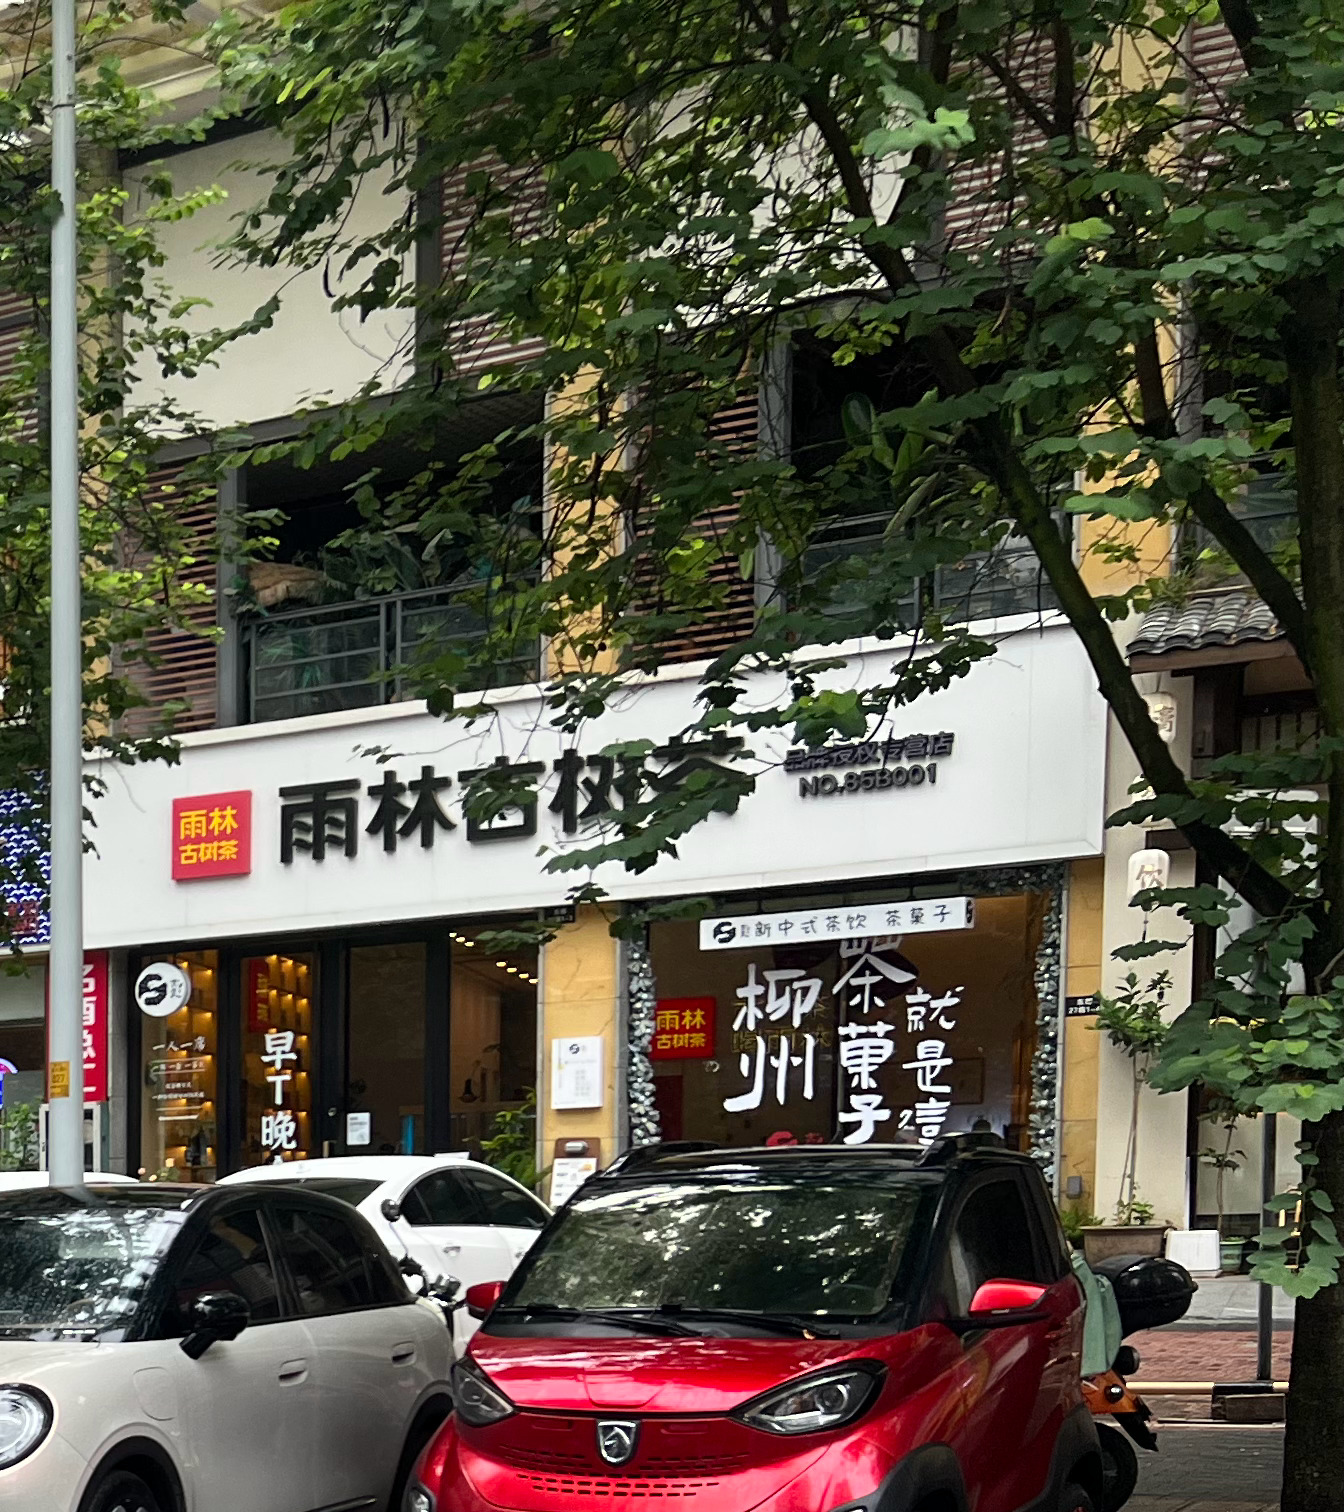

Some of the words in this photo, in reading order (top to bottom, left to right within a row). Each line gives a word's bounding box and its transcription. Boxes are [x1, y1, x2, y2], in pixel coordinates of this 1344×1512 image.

[179, 804, 239, 840] 雨林
[178, 840, 239, 865] 古树茶
[656, 1008, 707, 1031] 雨林
[655, 1033, 707, 1050] 古树茶
[723, 963, 823, 1113] 柳州
[261, 1030, 298, 1165] 早T晚
